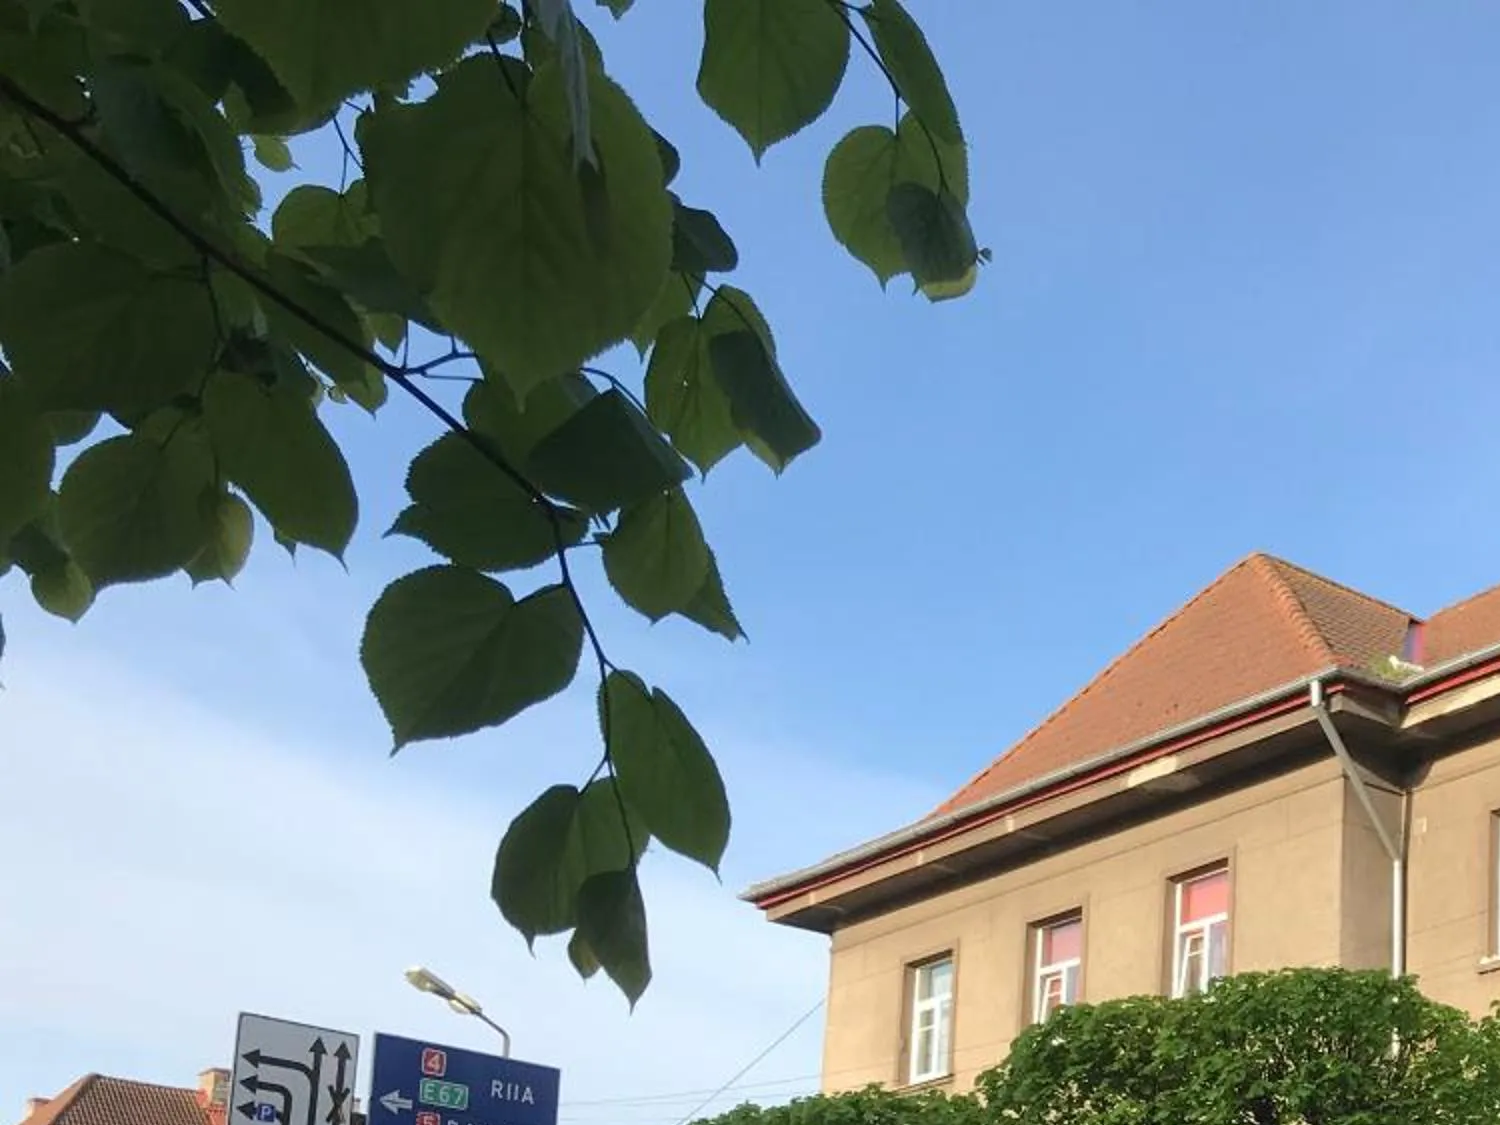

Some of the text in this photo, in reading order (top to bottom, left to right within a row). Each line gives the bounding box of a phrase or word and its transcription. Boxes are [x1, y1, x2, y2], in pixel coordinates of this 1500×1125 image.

[427, 1055, 441, 1069] 4
[423, 1082, 465, 1105] E67
[491, 1079, 535, 1105] RIIA
[261, 1105, 272, 1120] P
